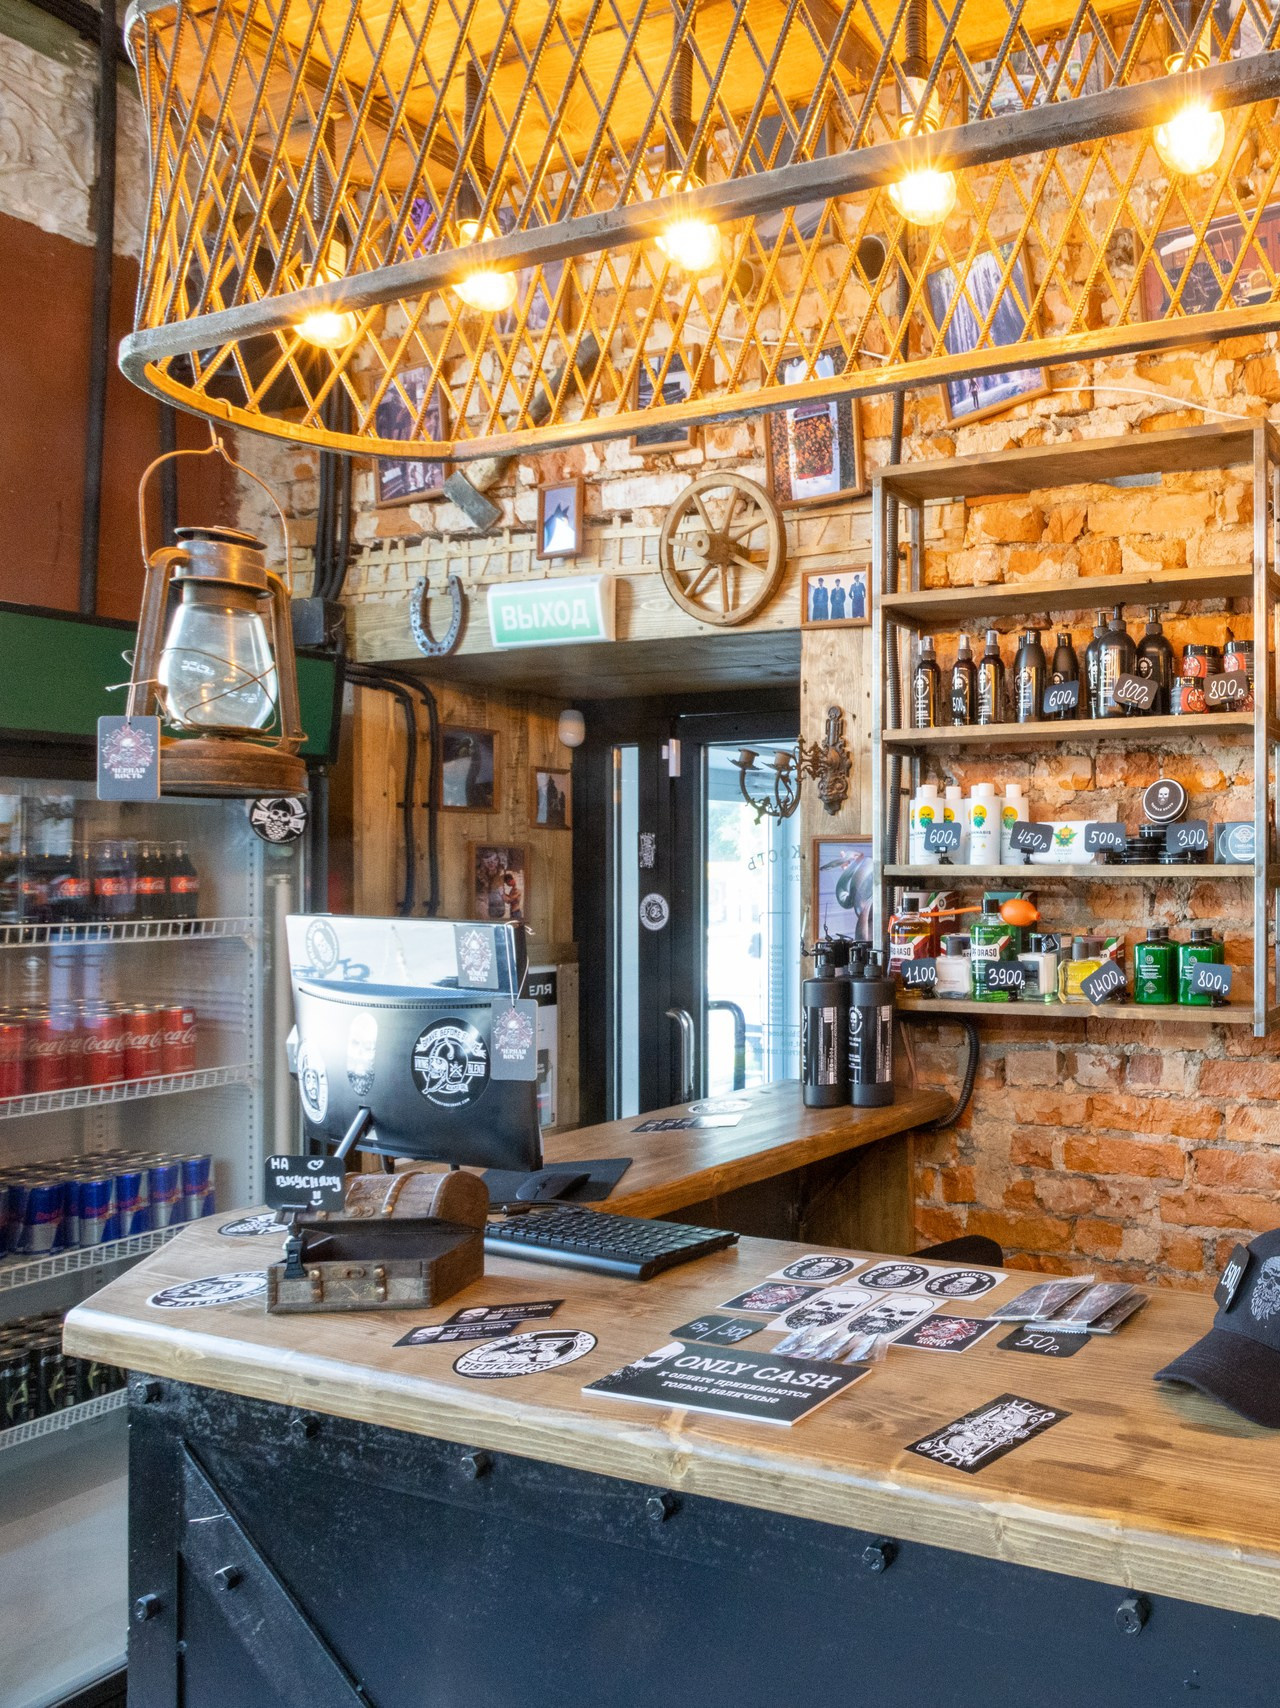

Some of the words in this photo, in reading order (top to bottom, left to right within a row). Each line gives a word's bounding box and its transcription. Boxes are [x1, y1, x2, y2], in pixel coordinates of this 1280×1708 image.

[501, 599, 591, 631] ВЫХОД
[1197, 970, 1229, 994] 800р
[271, 1158, 289, 1170] НА
[656, 1370, 666, 1378] к
[667, 1373, 715, 1386] оплате
[715, 1377, 812, 1399] принимаются
[673, 1355, 758, 1377] ONLY
[753, 1365, 842, 1390] CASH
[661, 1380, 710, 1394] только
[708, 1387, 780, 1404] наличные
